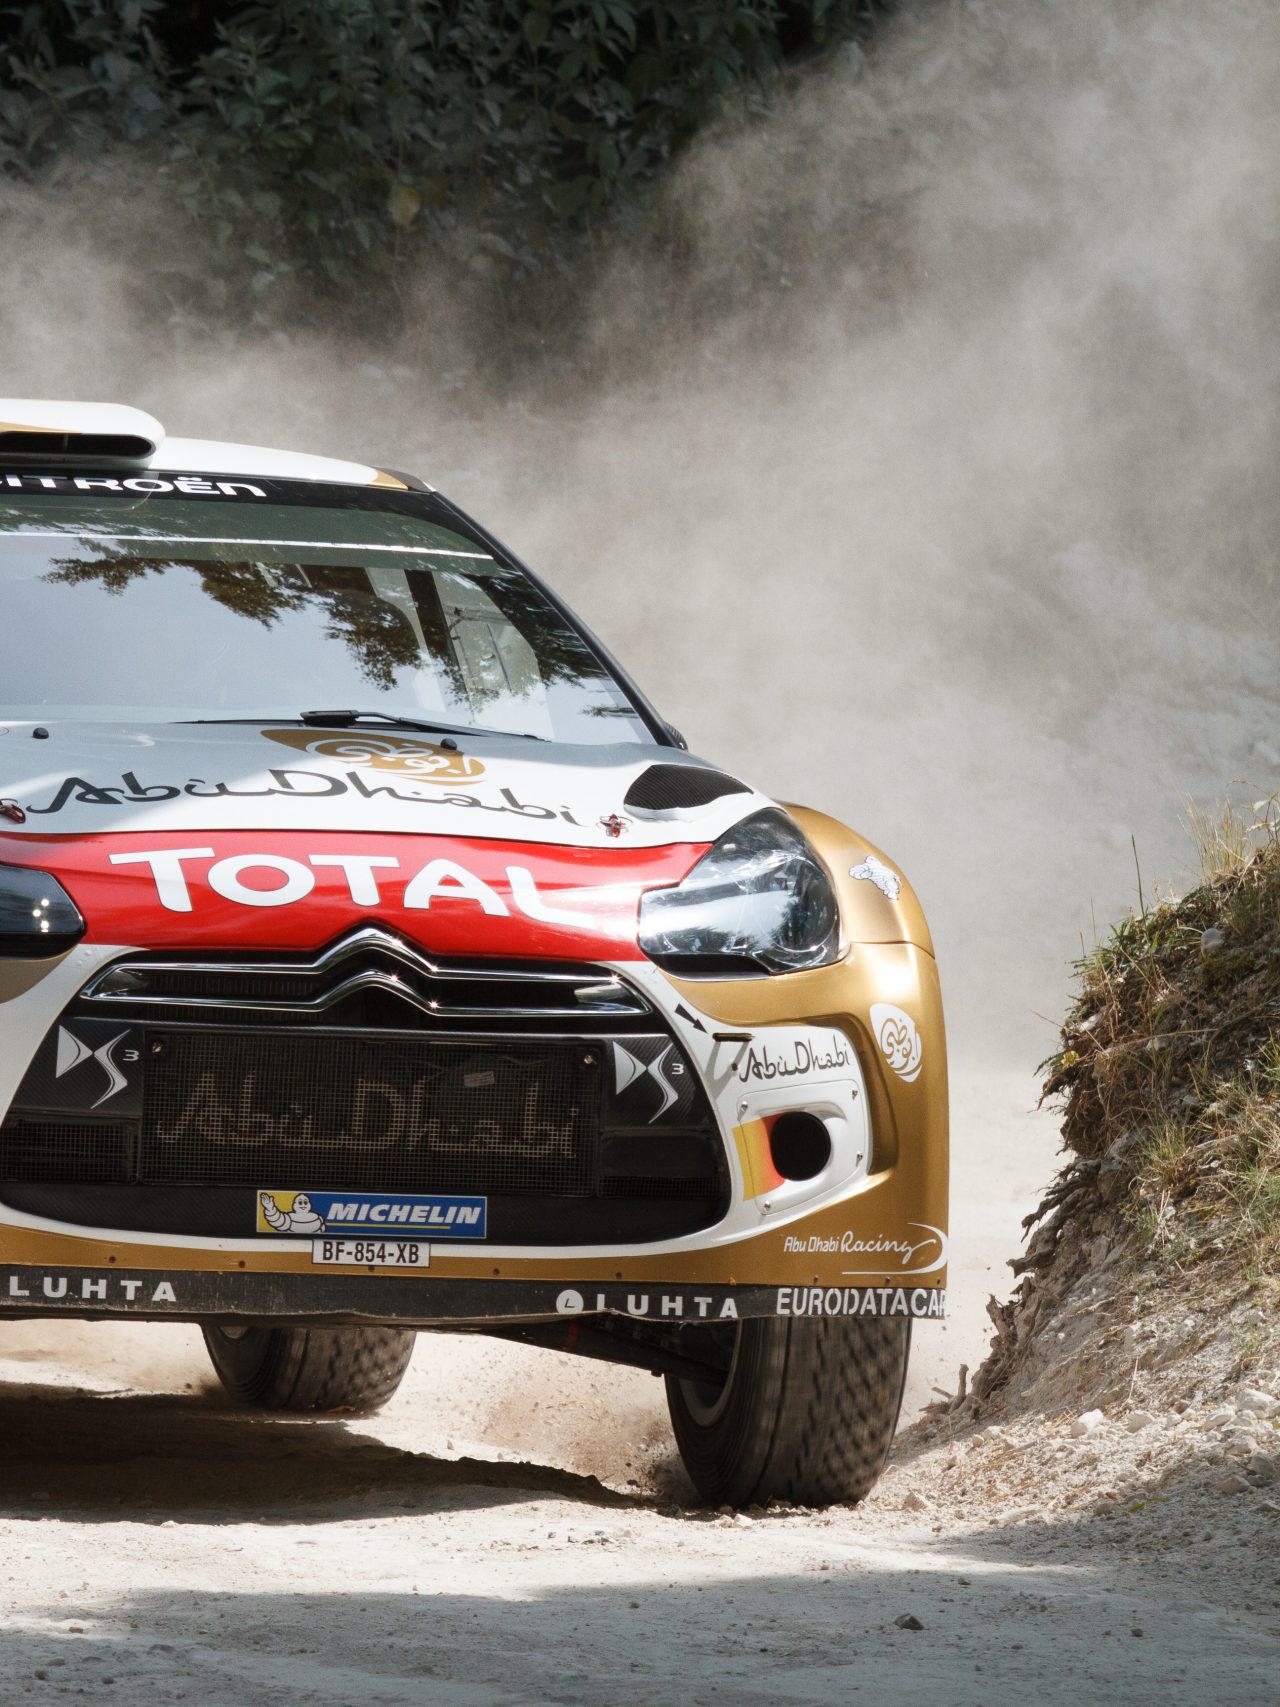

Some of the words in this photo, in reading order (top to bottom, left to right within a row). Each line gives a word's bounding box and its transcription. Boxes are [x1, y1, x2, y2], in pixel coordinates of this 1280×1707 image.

[108, 846, 600, 930] TOTAL
[326, 1203, 482, 1225] MICHELIN
[322, 1241, 420, 1264] BF-854-XB
[783, 1236, 805, 1252] Abu
[807, 1236, 839, 1253] Dhabi
[840, 1230, 937, 1265] Racing
[8, 1275, 177, 1303] LUHTA
[595, 1293, 739, 1319] LUHTA
